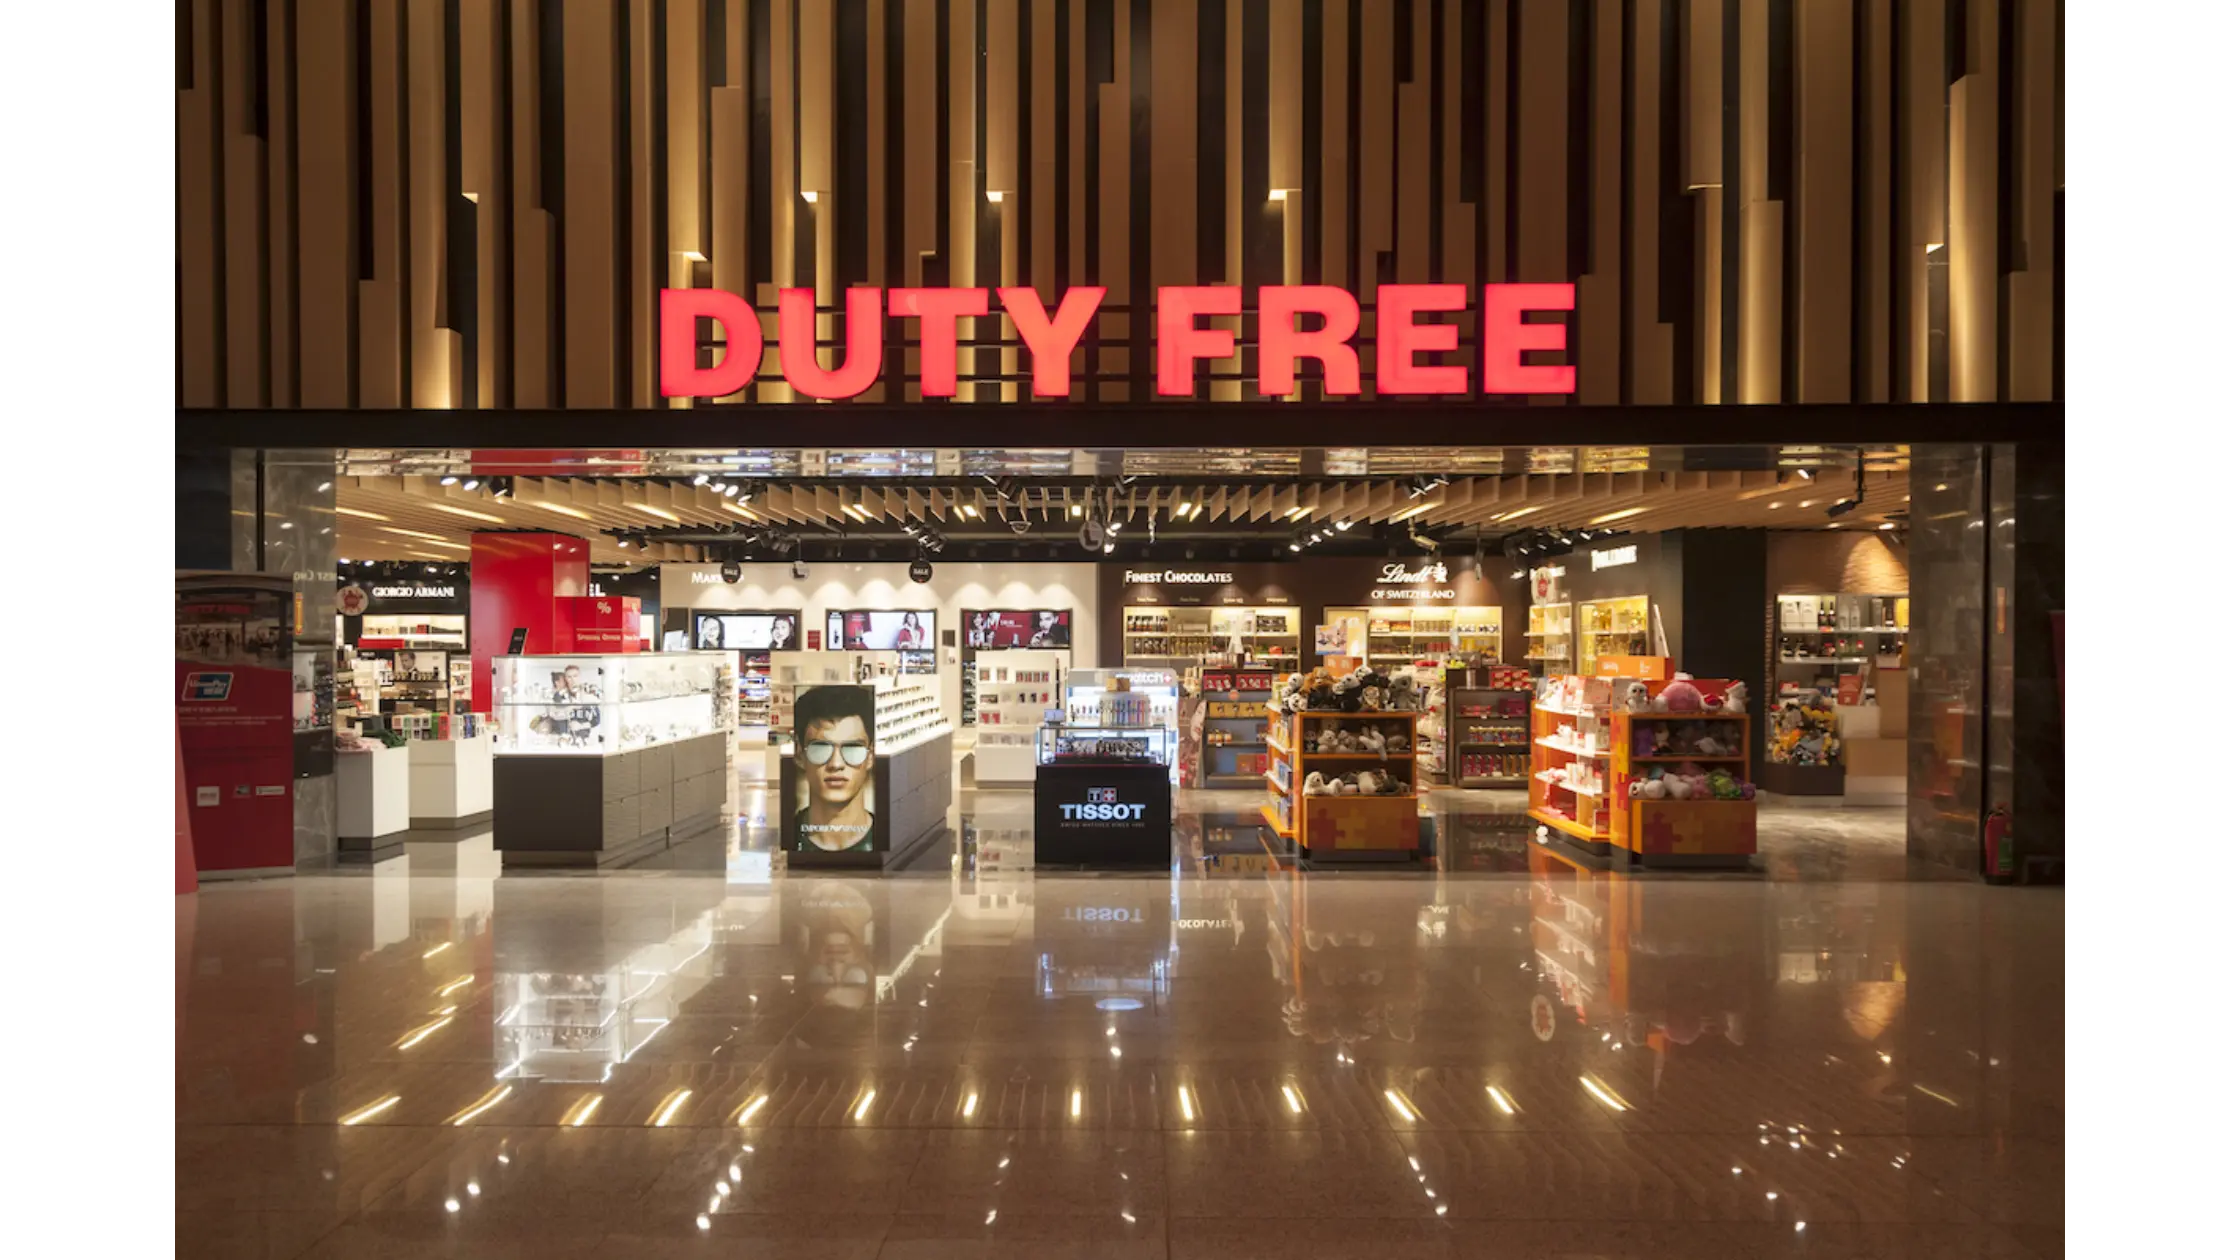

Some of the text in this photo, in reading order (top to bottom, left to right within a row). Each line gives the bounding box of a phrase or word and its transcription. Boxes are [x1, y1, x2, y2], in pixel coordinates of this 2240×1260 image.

[660, 283, 1576, 398] DUTY FREE
[913, 567, 929, 575] SALE
[1125, 570, 1233, 584] FINEST CHOCOLATES
[1376, 563, 1434, 583] Lindt
[372, 586, 455, 598] GIORGIO ARMANI
[1371, 589, 1455, 599] OF SWITZERLAND
[1059, 804, 1146, 820] TISSOT
